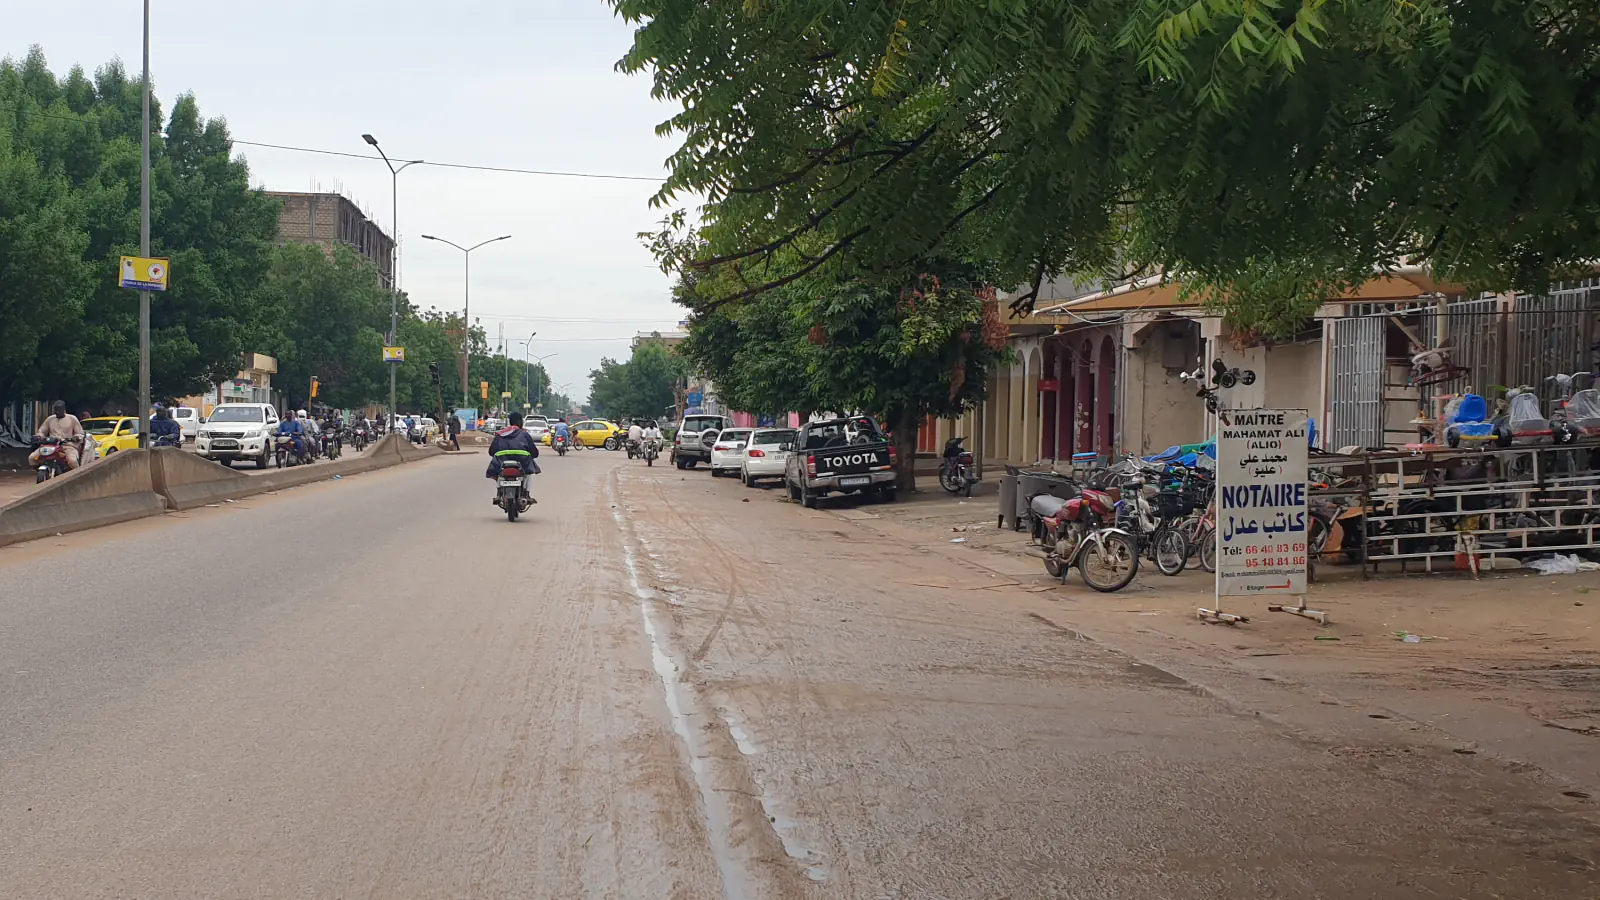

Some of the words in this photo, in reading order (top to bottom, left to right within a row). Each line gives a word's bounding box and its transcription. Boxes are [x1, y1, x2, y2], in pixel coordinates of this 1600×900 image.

[1234, 412, 1284, 426] MAÎTRE
[1223, 430, 1281, 439] MAHAMAT
[1285, 429, 1305, 438] ALI
[1247, 440, 1282, 449] (ALIO)
[823, 452, 879, 468] TOYOTA
[1240, 454, 1259, 468] علي
[1262, 454, 1288, 463] محمد
[1222, 483, 1305, 509] NOTAIRE
[1223, 515, 1259, 542] عدل
[1263, 511, 1305, 540] كاتب
[1222, 546, 1242, 555] Tél:
[1245, 545, 1258, 554] 66
[1260, 544, 1273, 553] 40
[1276, 543, 1289, 553] 83
[1292, 543, 1305, 552] 69
[1245, 558, 1259, 568] 95
[1262, 557, 1274, 566] 18
[1277, 557, 1289, 566] 81
